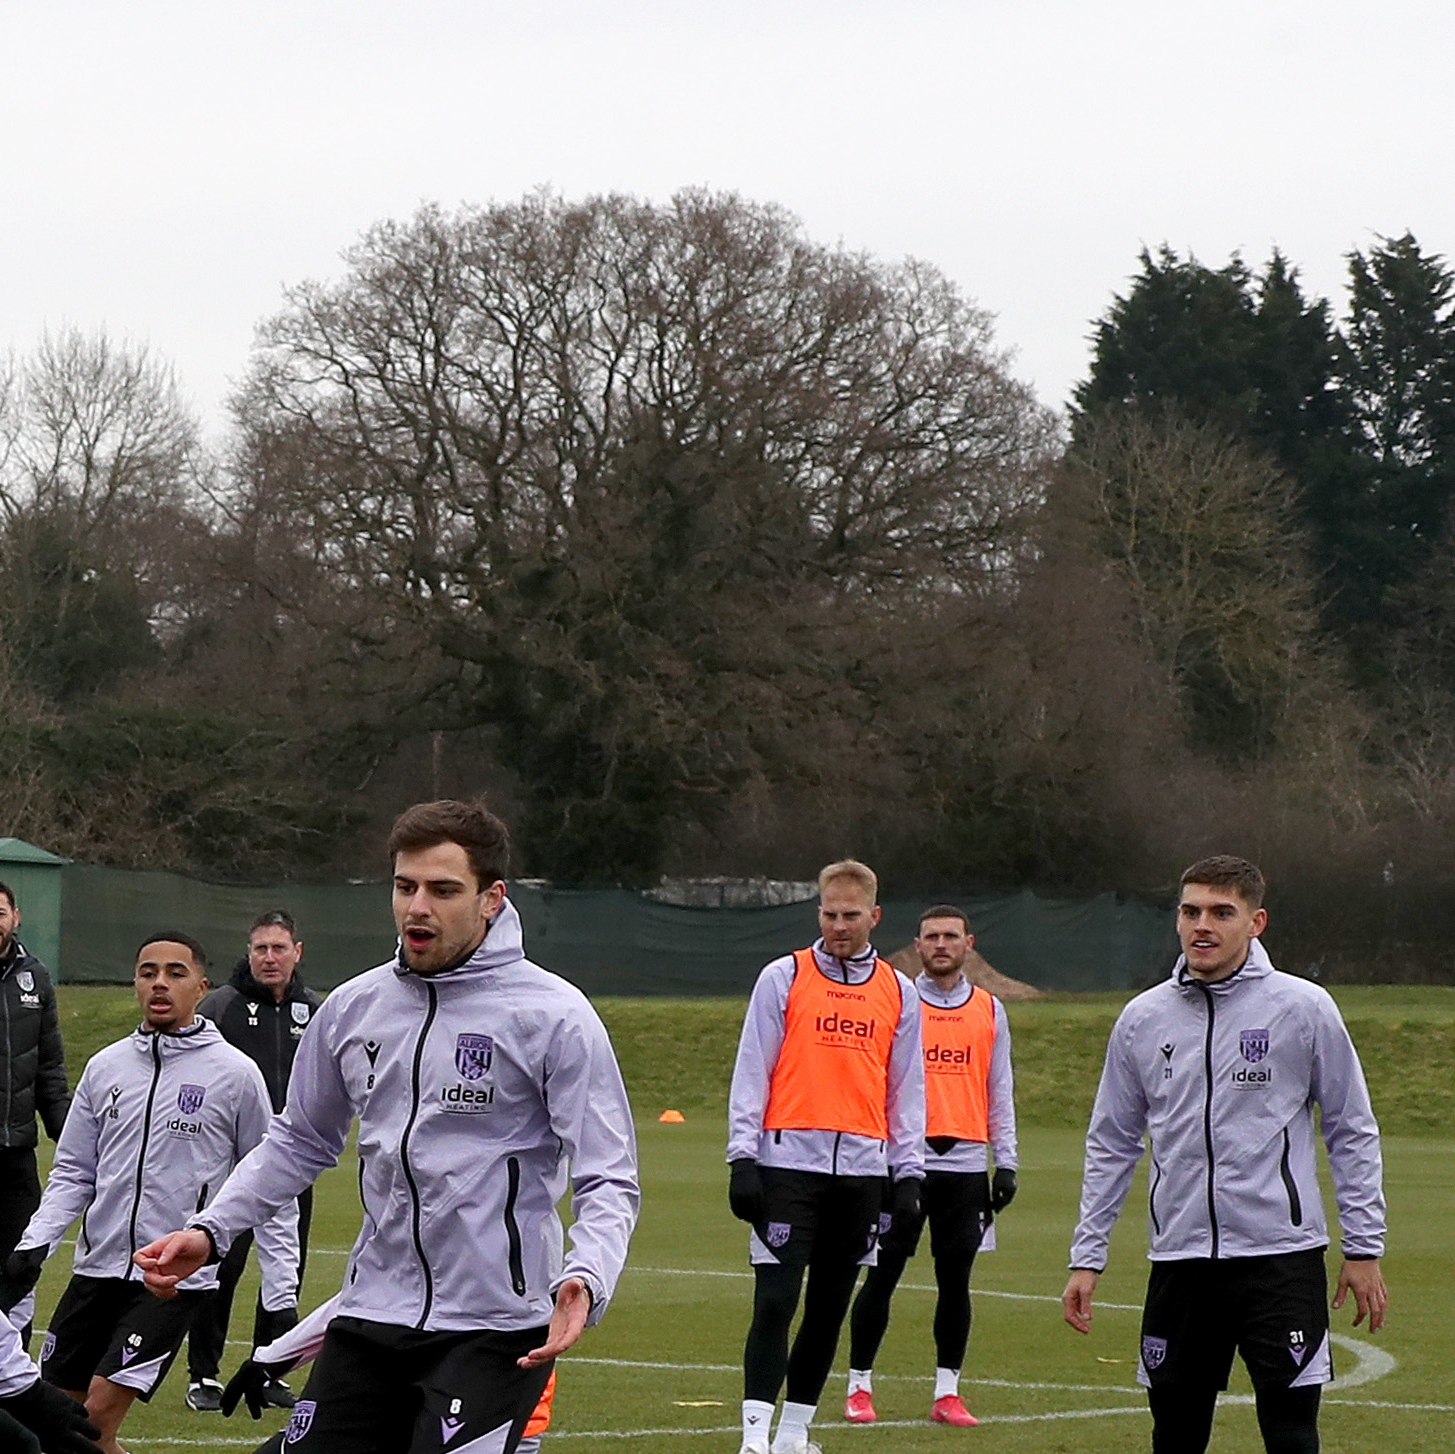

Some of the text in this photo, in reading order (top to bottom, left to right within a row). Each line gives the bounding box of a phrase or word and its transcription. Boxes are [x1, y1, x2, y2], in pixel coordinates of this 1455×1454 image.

[826, 990, 866, 1001] macron
[816, 1009, 875, 1039] ideal
[367, 1074, 375, 1090] 8
[1232, 1068, 1271, 1082] ideal
[441, 1082, 494, 1104] ideal
[166, 1117, 202, 1134] ideal
[128, 1333, 142, 1347] 46
[1289, 1330, 1304, 1344] 31
[450, 1399, 462, 1413] 8
